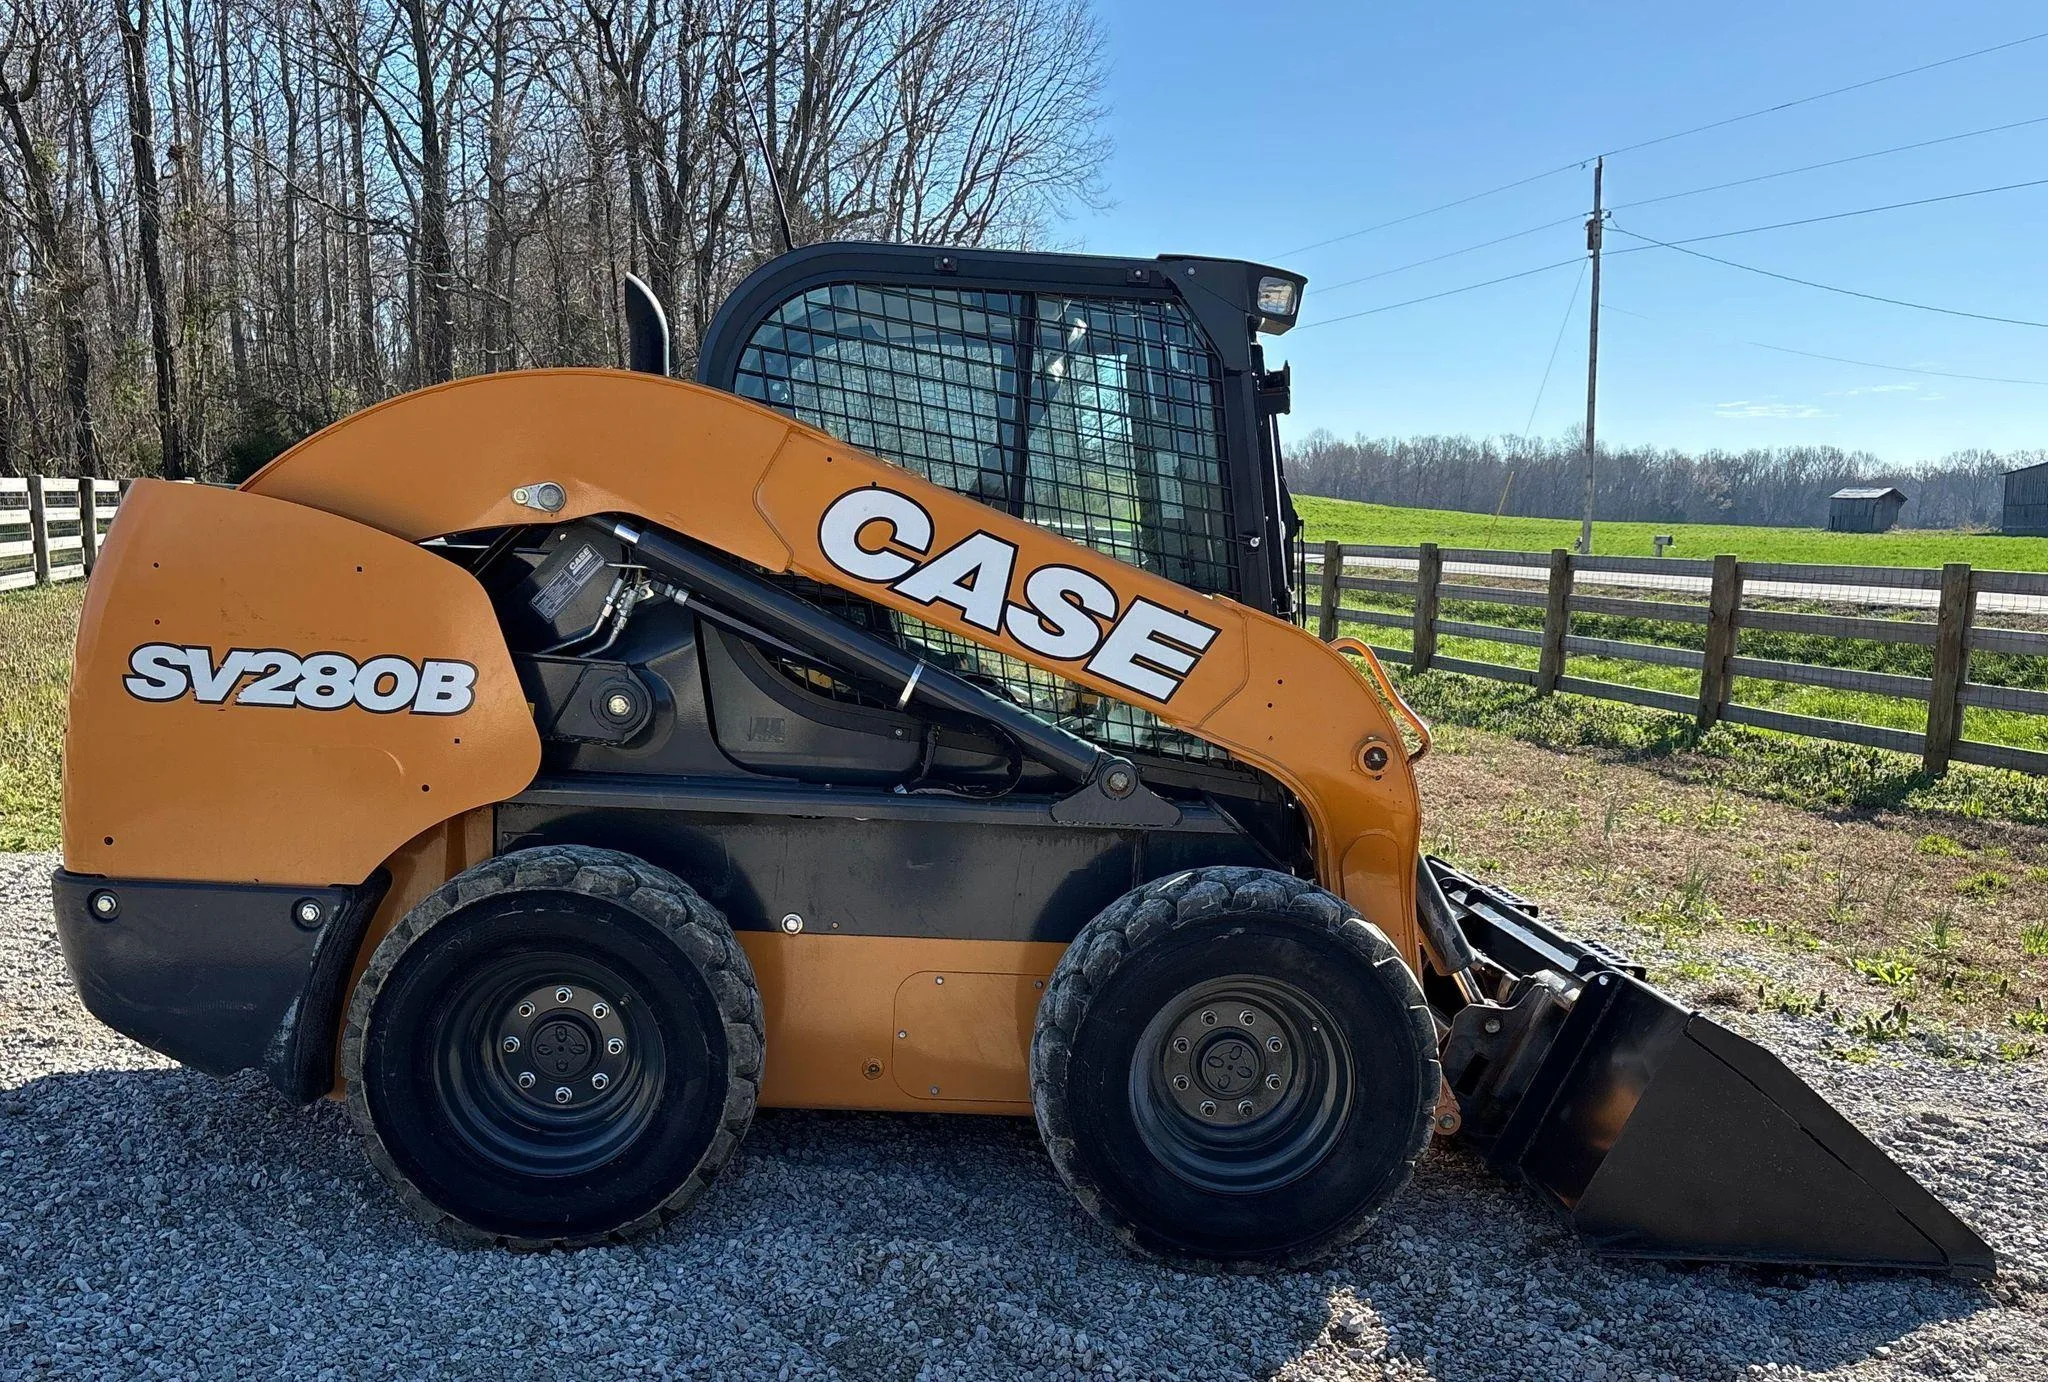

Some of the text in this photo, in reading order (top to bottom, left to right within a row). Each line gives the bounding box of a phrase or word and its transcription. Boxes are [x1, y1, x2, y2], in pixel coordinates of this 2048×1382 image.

[569, 547, 591, 571] CASE
[818, 486, 1222, 703] CASE
[122, 642, 479, 716] SV280B
